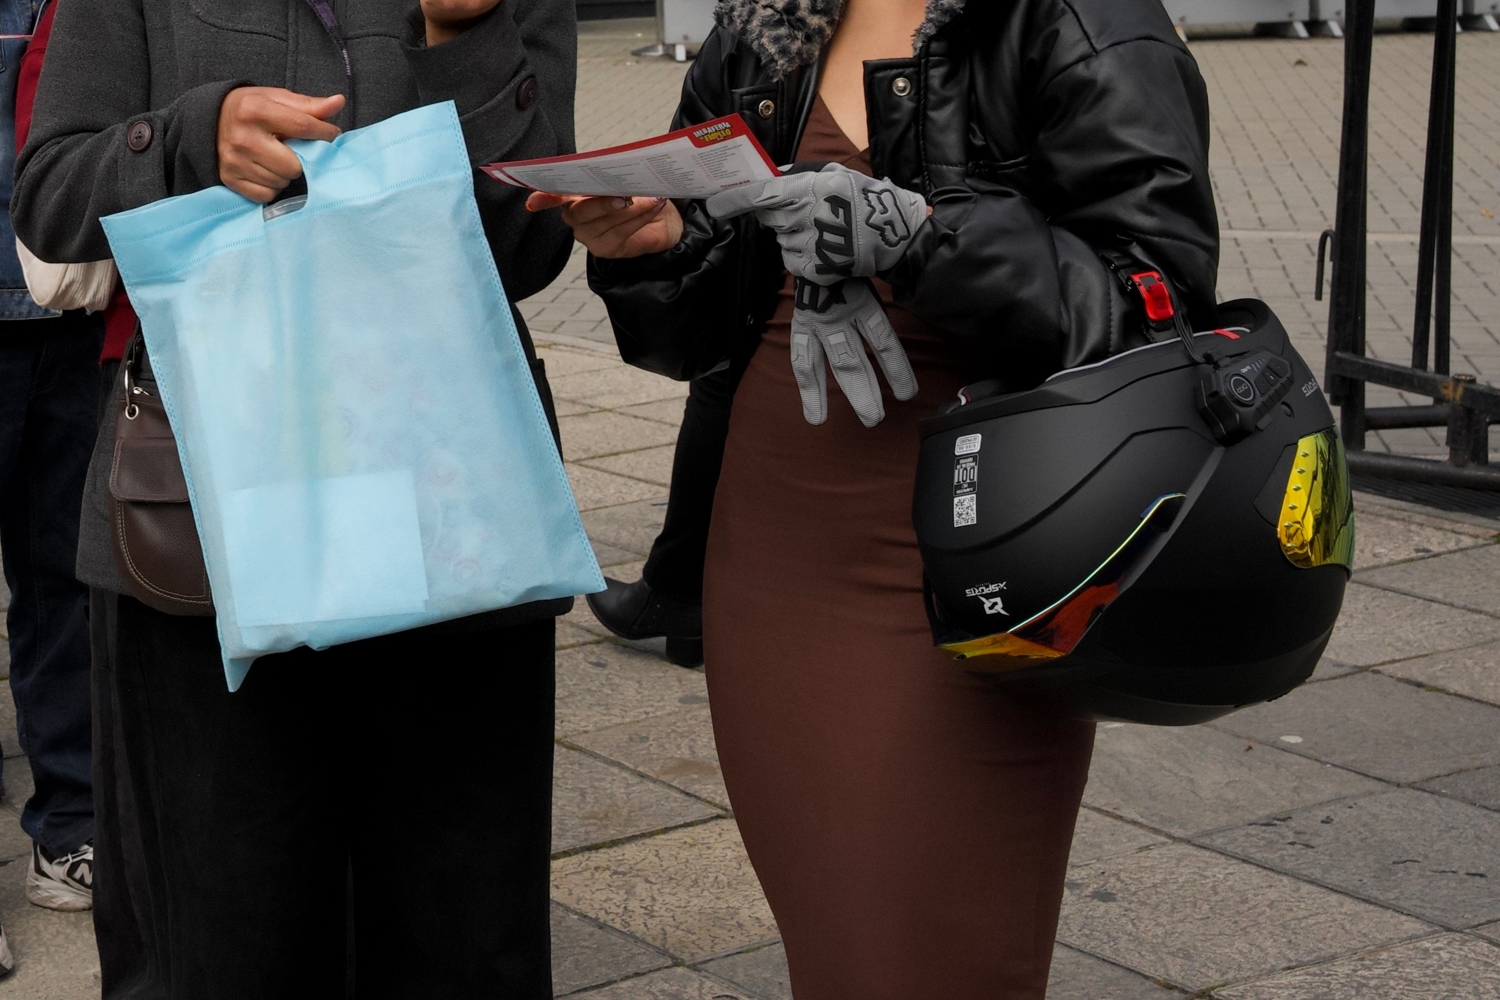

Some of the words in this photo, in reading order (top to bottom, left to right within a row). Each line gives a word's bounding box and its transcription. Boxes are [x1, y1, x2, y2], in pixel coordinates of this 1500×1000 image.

[703, 128, 732, 142] EMPLEO
[813, 194, 855, 277] FOX
[796, 276, 848, 314] OX
[956, 467, 975, 485] DOT
